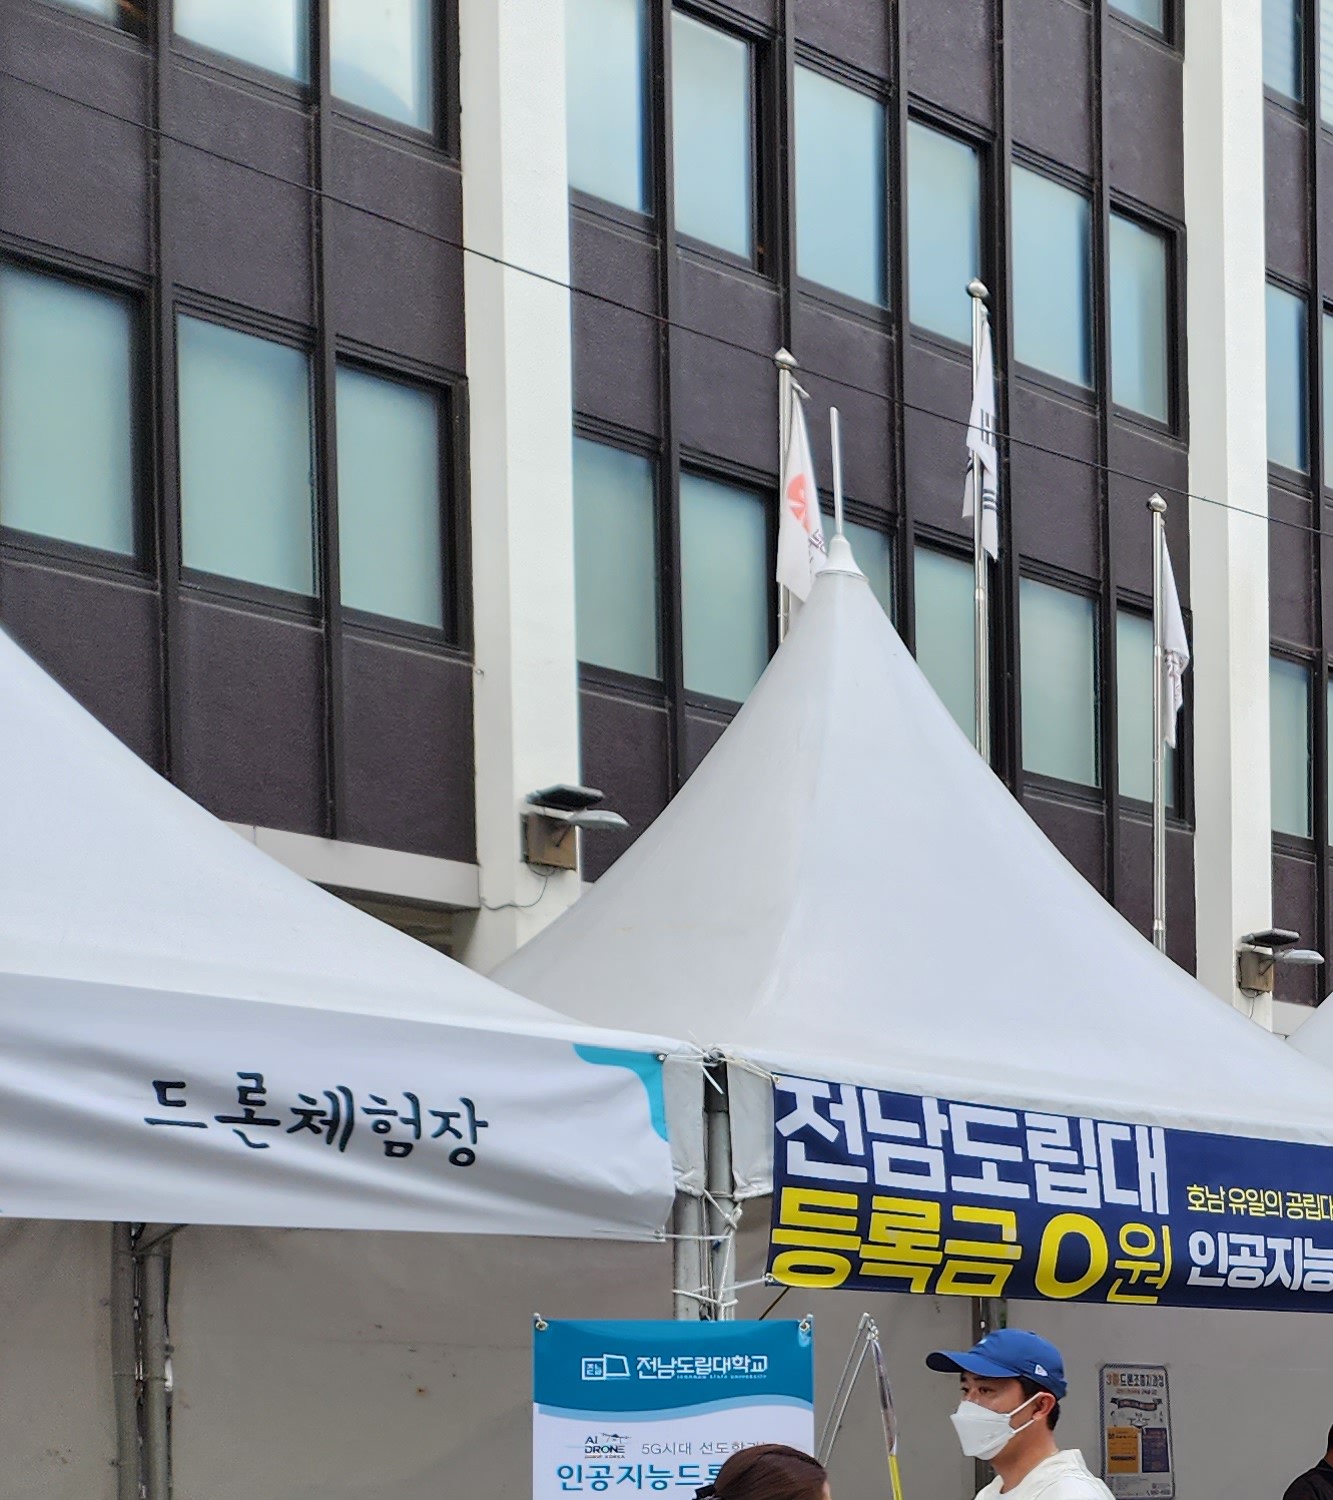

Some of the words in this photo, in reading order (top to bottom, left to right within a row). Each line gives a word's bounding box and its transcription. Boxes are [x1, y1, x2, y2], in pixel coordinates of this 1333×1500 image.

[144, 1072, 489, 1168] 드론체험장
[775, 1076, 1170, 1215] 전남도립대
[1186, 1184, 1225, 1215] 호남
[1228, 1187, 1284, 1218] 유일의
[771, 1187, 1023, 1297] 등록금
[637, 1355, 768, 1379] 전남도립대학교
[584, 1436, 598, 1444] AI
[584, 1445, 625, 1454] DRONE
[641, 1442, 692, 1455] 5G시대
